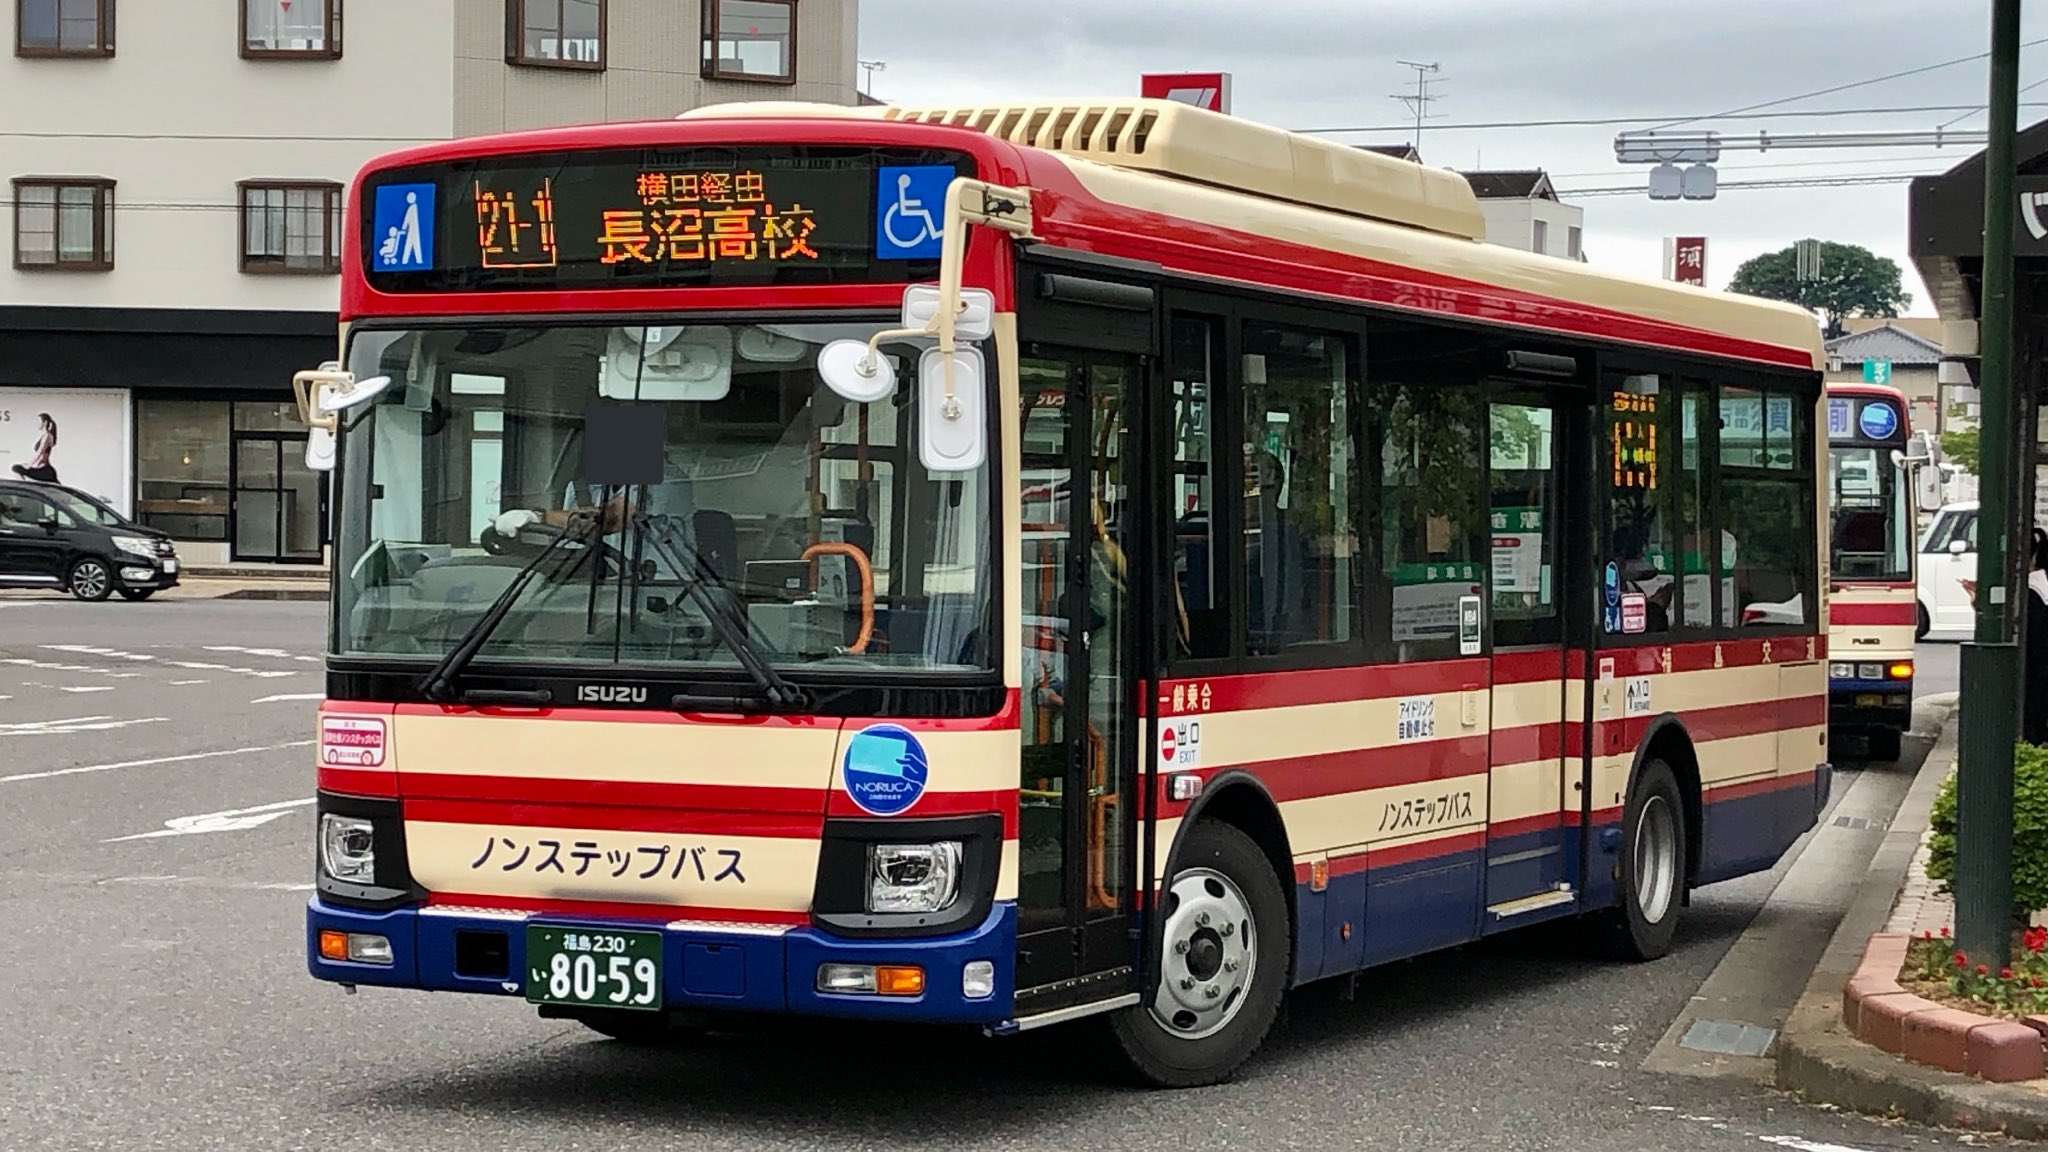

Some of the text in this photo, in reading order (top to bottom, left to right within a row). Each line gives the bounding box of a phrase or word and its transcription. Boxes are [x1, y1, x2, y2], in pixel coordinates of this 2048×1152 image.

[636, 170, 764, 206] 横田経由
[598, 203, 818, 263] 長沼高校
[577, 685, 647, 703] ISUZU
[1159, 682, 1212, 713] 一般乗合
[1399, 700, 1434, 719] アイドリング
[1178, 722, 1199, 746] 出口
[1179, 750, 1196, 763] EXIT
[855, 782, 914, 793] NORUCA
[1378, 792, 1472, 832] ノンステップバス
[471, 836, 746, 884] ノンステップバス
[592, 935, 625, 953] 230
[549, 952, 656, 1005] 80-59
